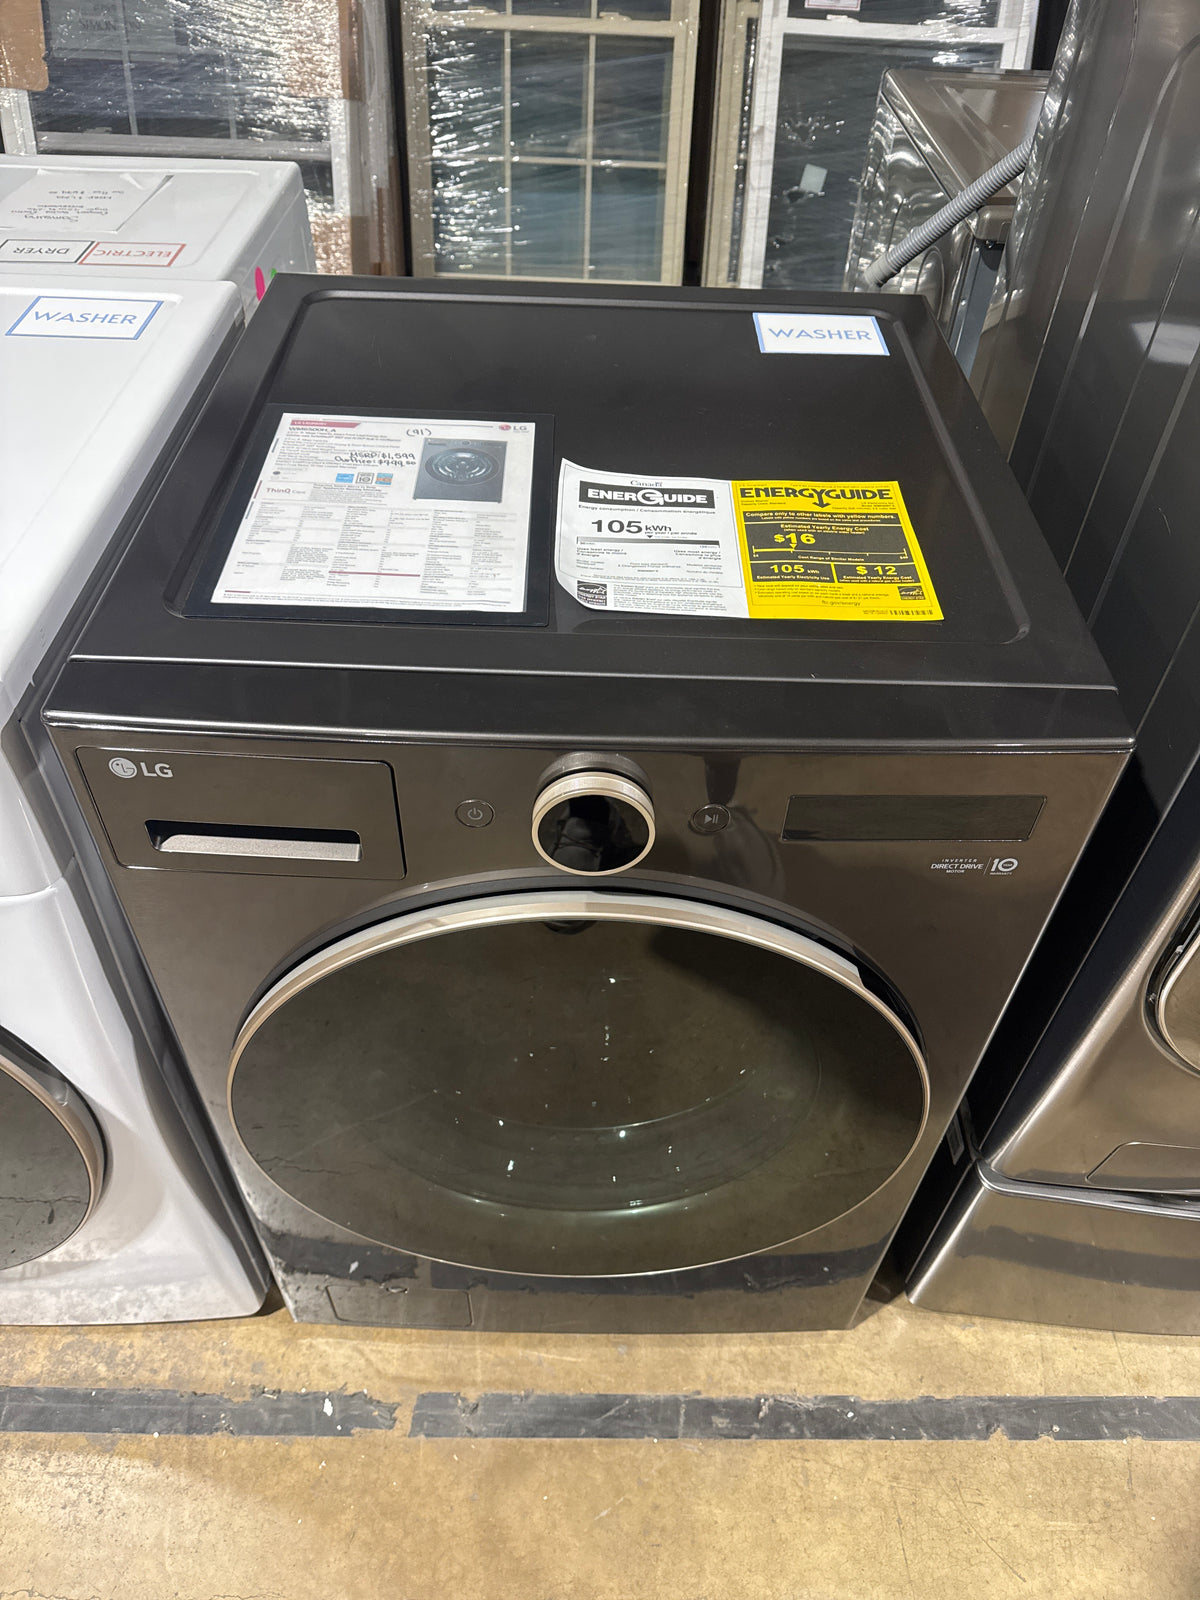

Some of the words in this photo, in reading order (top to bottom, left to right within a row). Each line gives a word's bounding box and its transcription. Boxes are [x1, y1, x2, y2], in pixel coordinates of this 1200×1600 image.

[93, 249, 172, 257] ELECTRIC
[34, 311, 138, 324] WASHER
[768, 328, 872, 340] WASHER
[406, 428, 432, 437] (91)
[266, 487, 291, 495] ThinQ
[591, 519, 643, 534] 105
[645, 524, 673, 532] kWh
[774, 532, 816, 545] $16
[771, 564, 805, 574] 105
[856, 565, 868, 576] $
[874, 566, 899, 576] 12
[140, 761, 174, 778] LG
[990, 858, 1019, 873] 10
